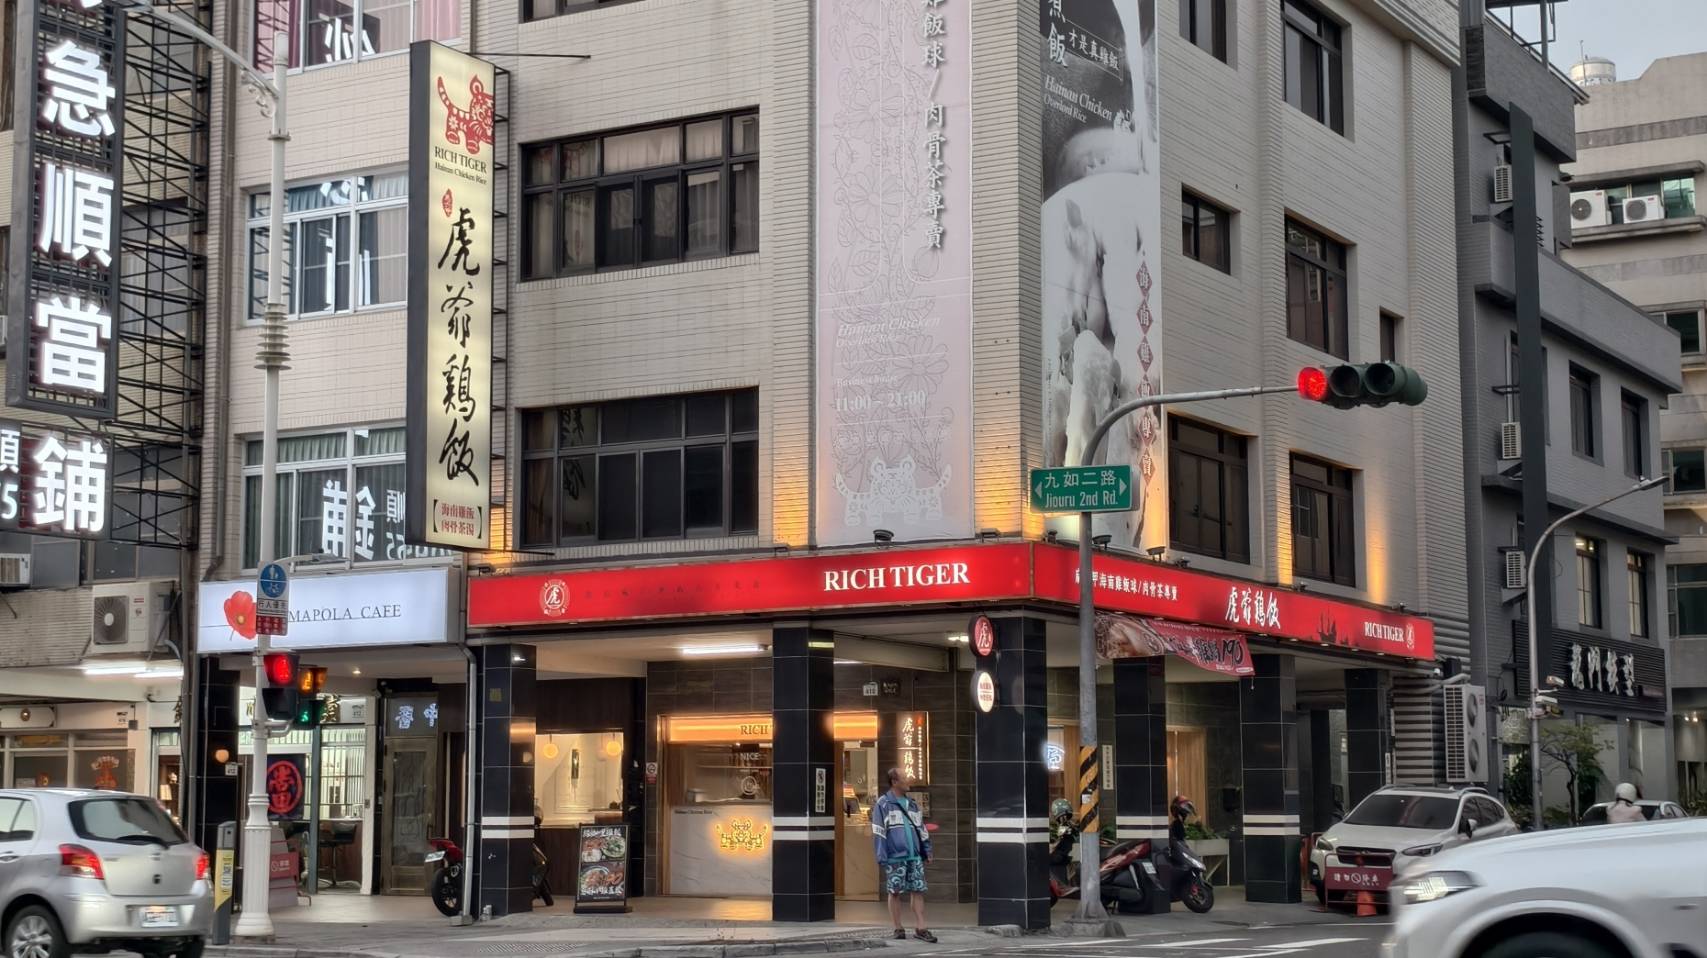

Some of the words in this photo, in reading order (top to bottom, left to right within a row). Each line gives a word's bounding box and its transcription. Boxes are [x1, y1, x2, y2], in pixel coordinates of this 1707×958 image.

[1044, 75, 1078, 104] Hainan
[1079, 93, 1112, 120] Chicken
[435, 146, 457, 164] RICH
[459, 154, 487, 174] TIGER
[33, 0, 116, 532] 急順當鋪
[1045, 470, 1116, 488] 九如二路
[1045, 493, 1075, 508] Jiouru
[1080, 491, 1098, 506] 2nd
[1103, 490, 1118, 505] Rd.
[824, 567, 886, 591] RICH
[889, 562, 970, 588] TIGER
[361, 604, 401, 618] CAFE
[977, 622, 990, 648] 虎
[1364, 621, 1382, 639] RICH
[1383, 625, 1404, 643] TIGER
[740, 725, 768, 736] RICH
